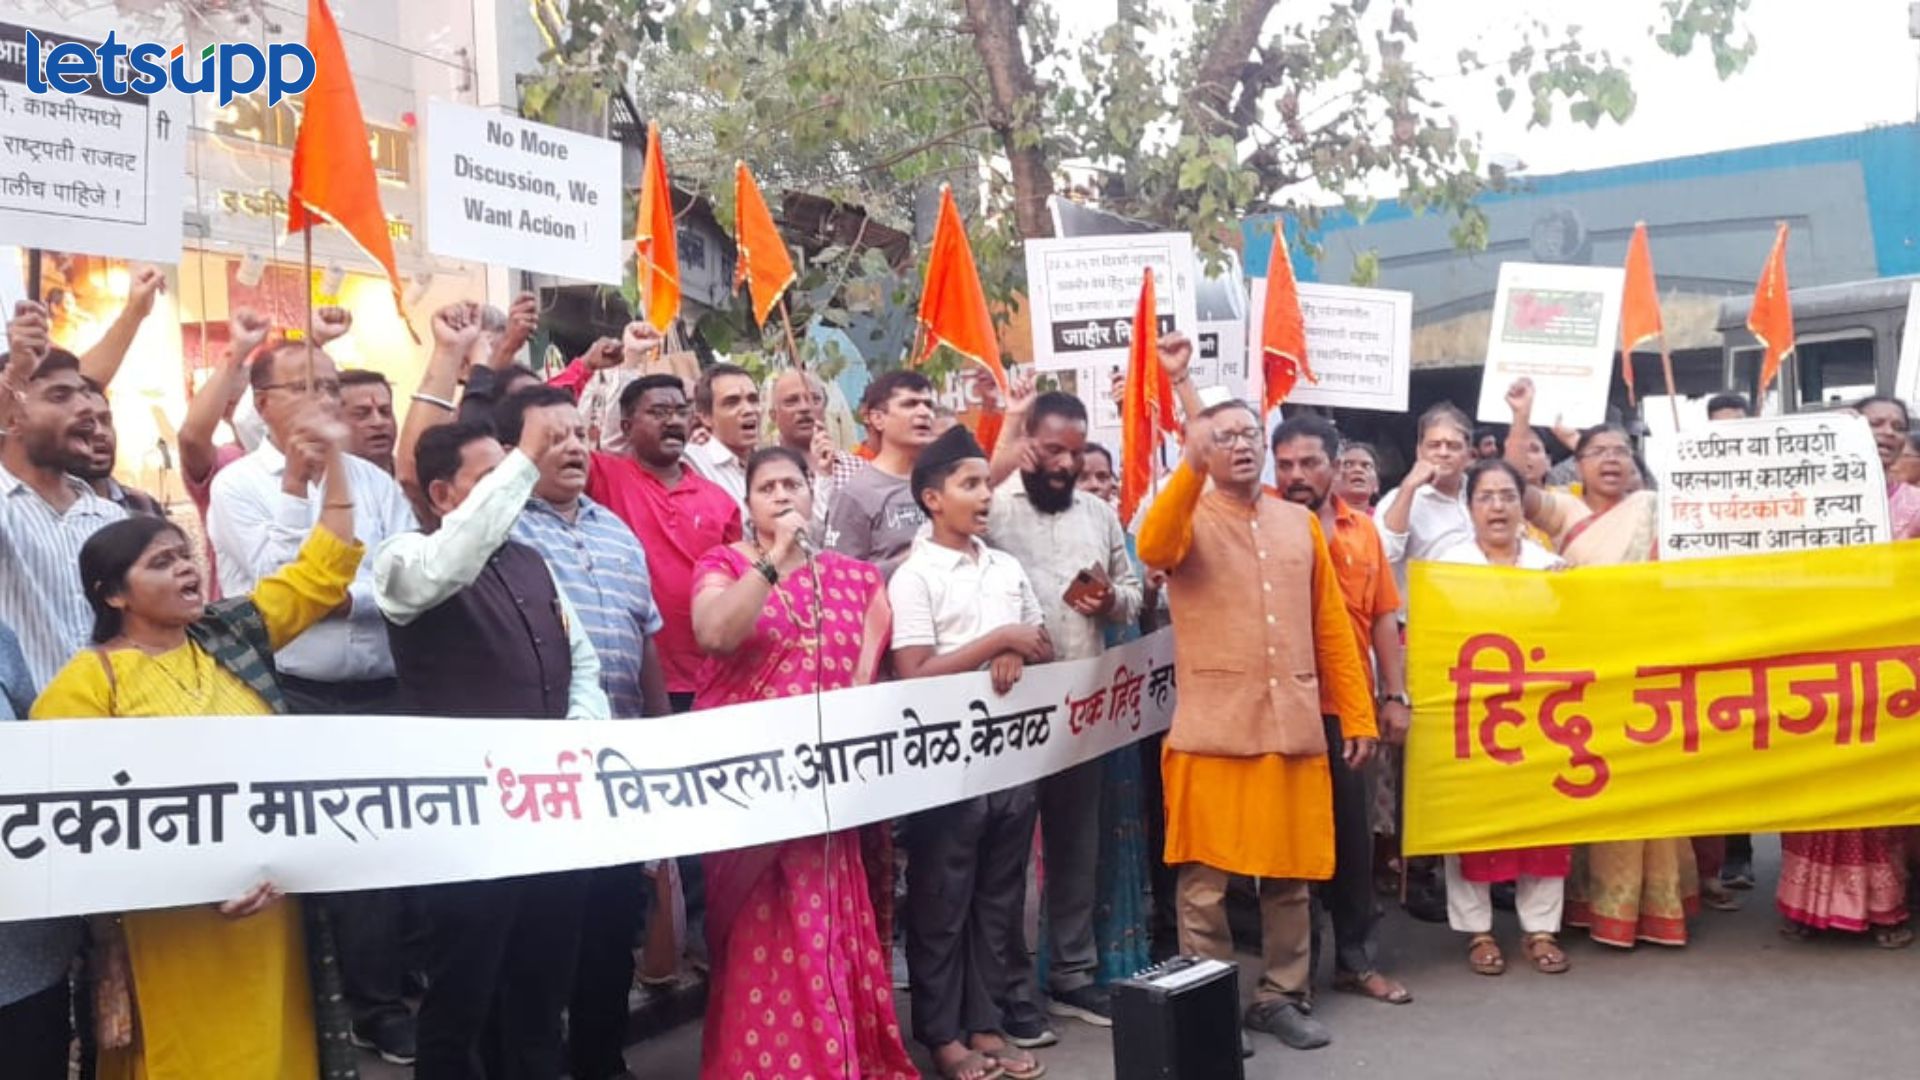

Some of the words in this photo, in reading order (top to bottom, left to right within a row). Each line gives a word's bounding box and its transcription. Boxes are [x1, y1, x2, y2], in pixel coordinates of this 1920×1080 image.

[487, 120, 513, 148] No
[521, 129, 568, 160] More
[455, 154, 561, 200] Discussion,
[568, 179, 598, 206] We
[464, 197, 512, 228] Want
[518, 209, 576, 240] Action
[248, 776, 487, 844] मारताना
